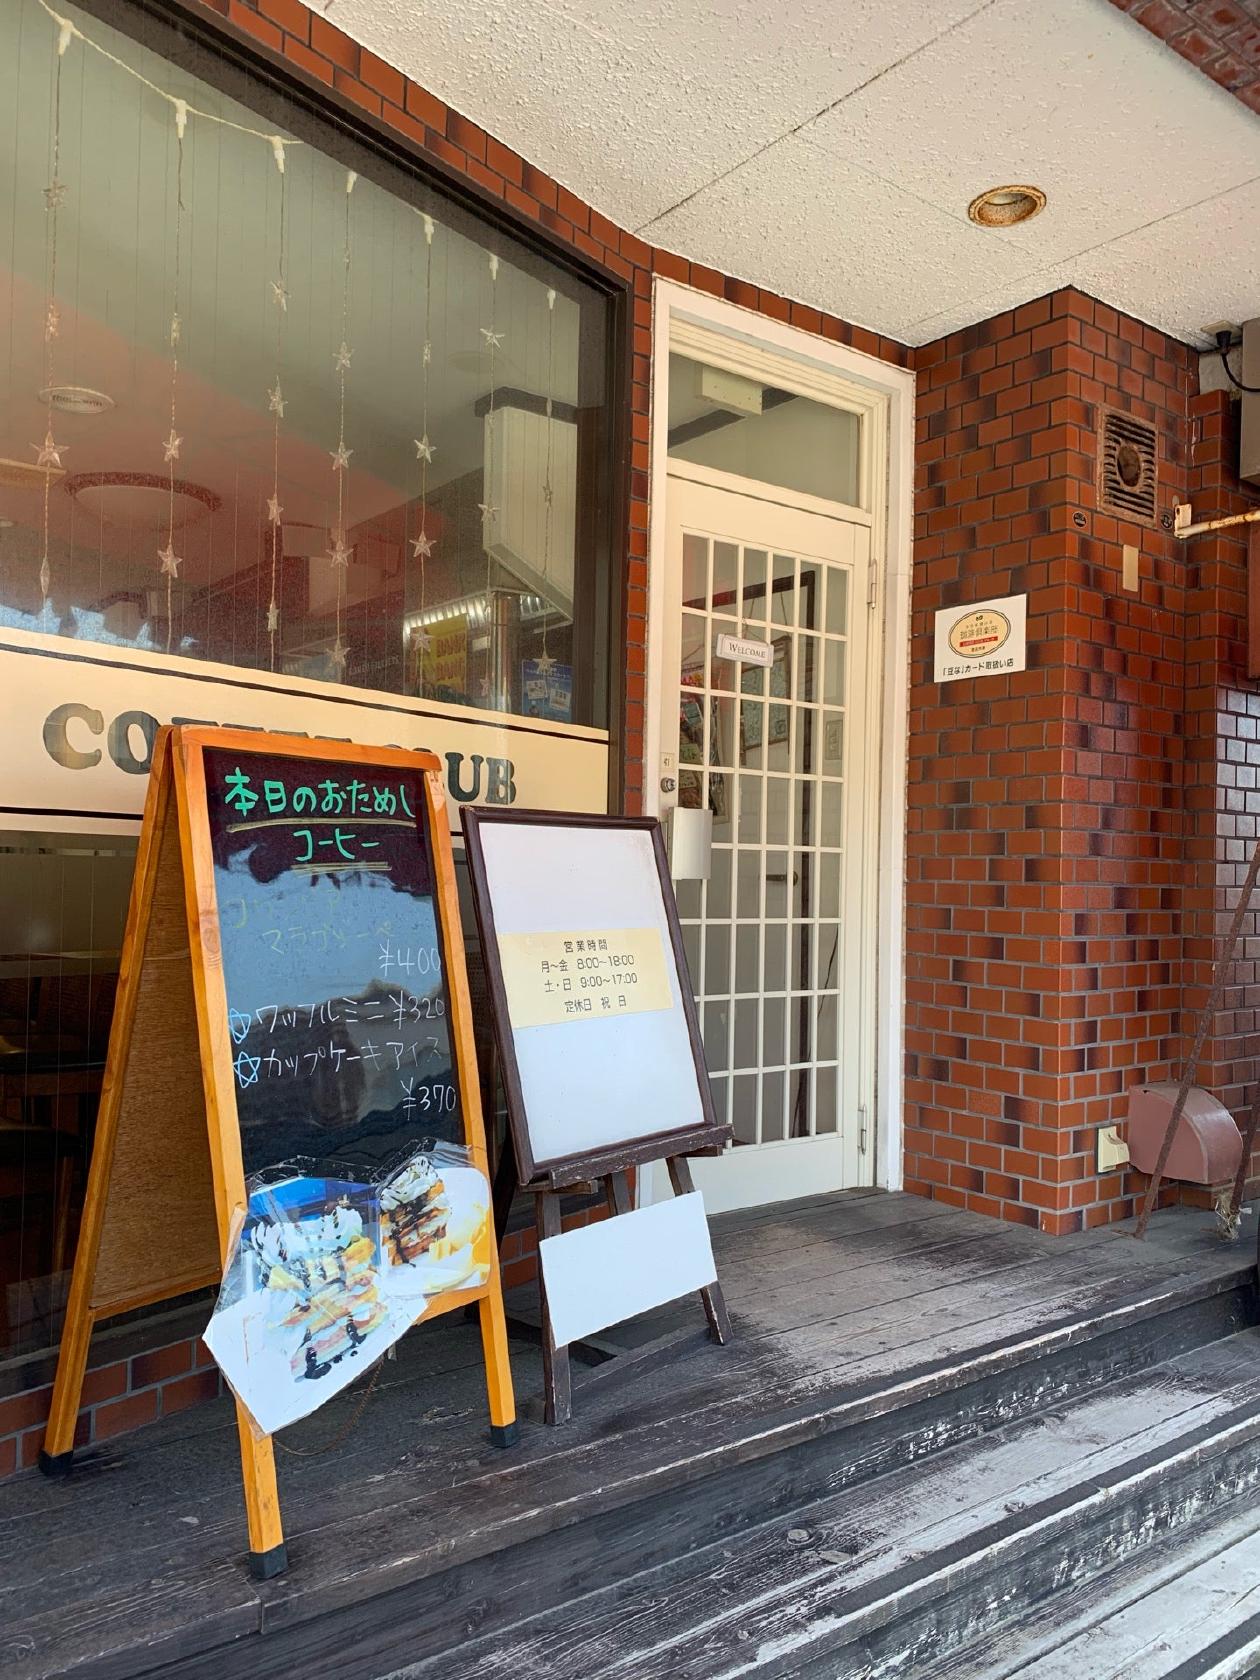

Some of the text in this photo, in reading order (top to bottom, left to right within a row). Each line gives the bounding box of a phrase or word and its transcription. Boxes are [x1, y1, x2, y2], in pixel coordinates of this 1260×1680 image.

[729, 641, 766, 659] WELCOME
[224, 767, 416, 817] 本日のおためし
[293, 828, 381, 862] コーヒー
[379, 939, 441, 977] ¥400
[563, 939, 608, 954] 営業時間
[564, 998, 592, 1013] 定休日
[401, 1077, 457, 1120] ¥370
